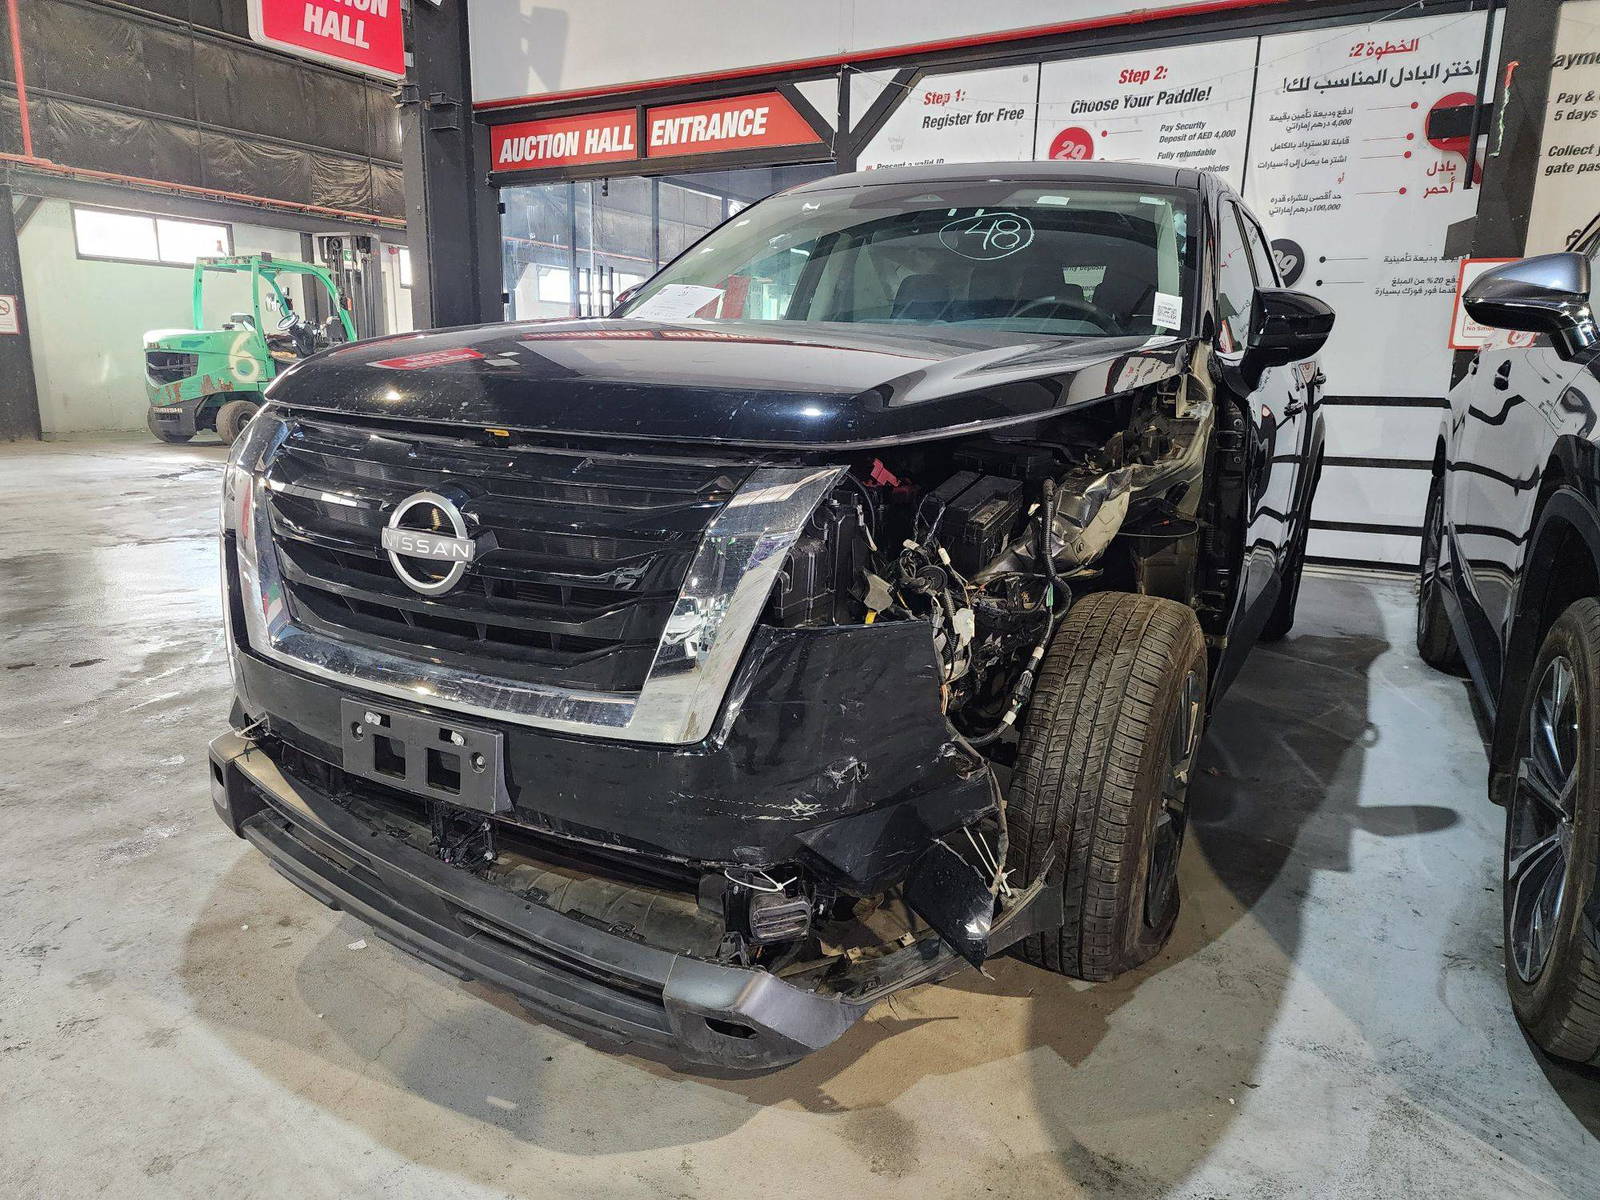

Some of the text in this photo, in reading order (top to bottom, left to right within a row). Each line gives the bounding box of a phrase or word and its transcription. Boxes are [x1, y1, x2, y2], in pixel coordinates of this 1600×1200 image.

[303, 3, 370, 50] HALL
[1366, 37, 1420, 61] الخطوة
[1552, 51, 1600, 70] aym
[1119, 66, 1168, 85] Step 2:
[1314, 68, 1388, 94] المناسب
[1390, 63, 1441, 88] البادل
[1442, 59, 1481, 84] اختر
[923, 89, 966, 106] Step 1:
[1071, 86, 1212, 114] Choose Your Paddle!
[1556, 92, 1583, 106] Pay
[1585, 90, 1596, 102] &
[922, 107, 1025, 130] Register for Free
[1331, 119, 1352, 128] 4,000
[1554, 108, 1599, 122] 5 days
[650, 106, 769, 147] ENTRANCE
[1160, 121, 1207, 133] Pay Security
[1310, 121, 1331, 131] درهم
[499, 125, 634, 164] AUCTION HALL
[1159, 129, 1237, 144] Deposit of AED 4,000
[1056, 140, 1087, 160] 29
[1157, 148, 1217, 161] Fully refundable
[1548, 143, 1595, 157] Collect
[1426, 160, 1457, 177] بادل
[1544, 162, 1575, 176] gate
[1423, 176, 1456, 199] أحمر
[1313, 204, 1341, 212] 100,000
[964, 219, 1021, 250] 48
[229, 332, 260, 384] 6
[382, 529, 470, 558] NISSAN
